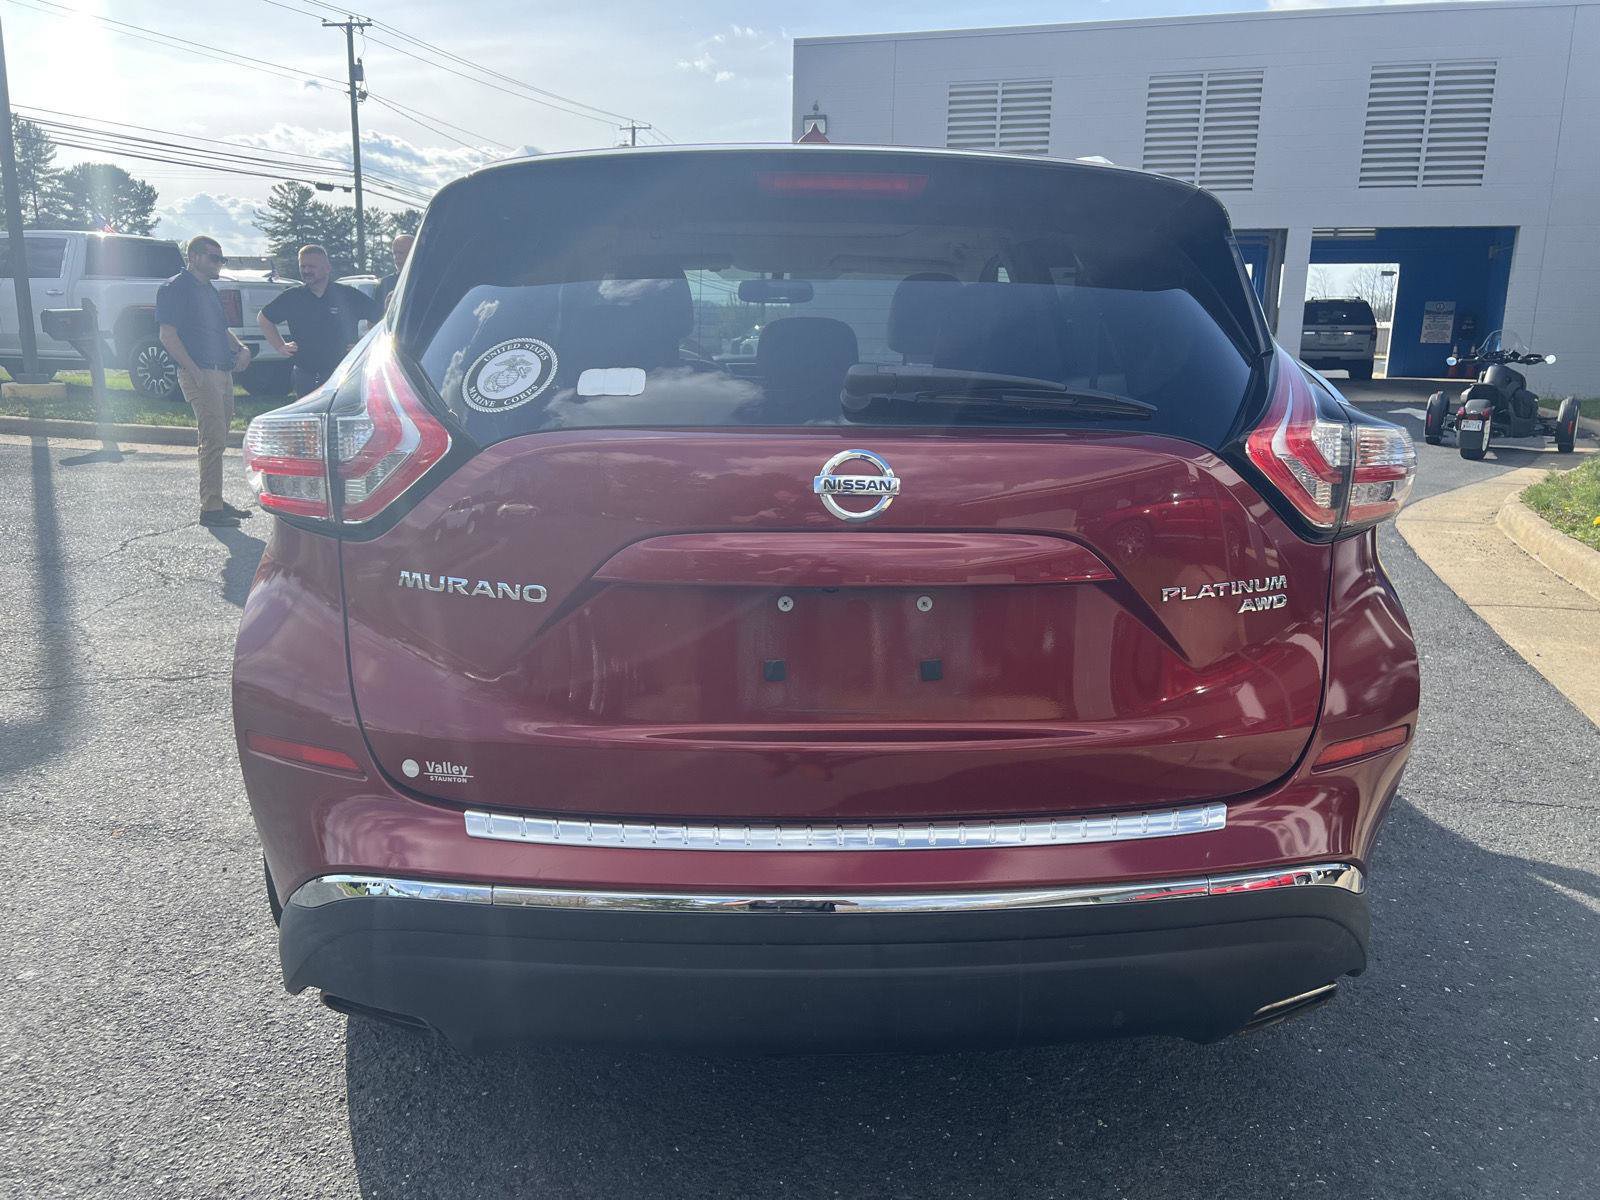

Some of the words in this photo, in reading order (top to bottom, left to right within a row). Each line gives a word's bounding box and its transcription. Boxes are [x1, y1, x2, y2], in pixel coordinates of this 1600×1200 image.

[484, 343, 520, 362] UNITED
[524, 343, 549, 361] STATES
[468, 386, 496, 407] MARINE
[503, 384, 539, 406] CORPS
[823, 479, 891, 491] NISSAN
[398, 570, 548, 603] MURANO
[1161, 575, 1288, 602] PLATINUM
[1237, 593, 1288, 614] AWD
[425, 761, 468, 777] Valley
[430, 775, 467, 784] STAUNTON
